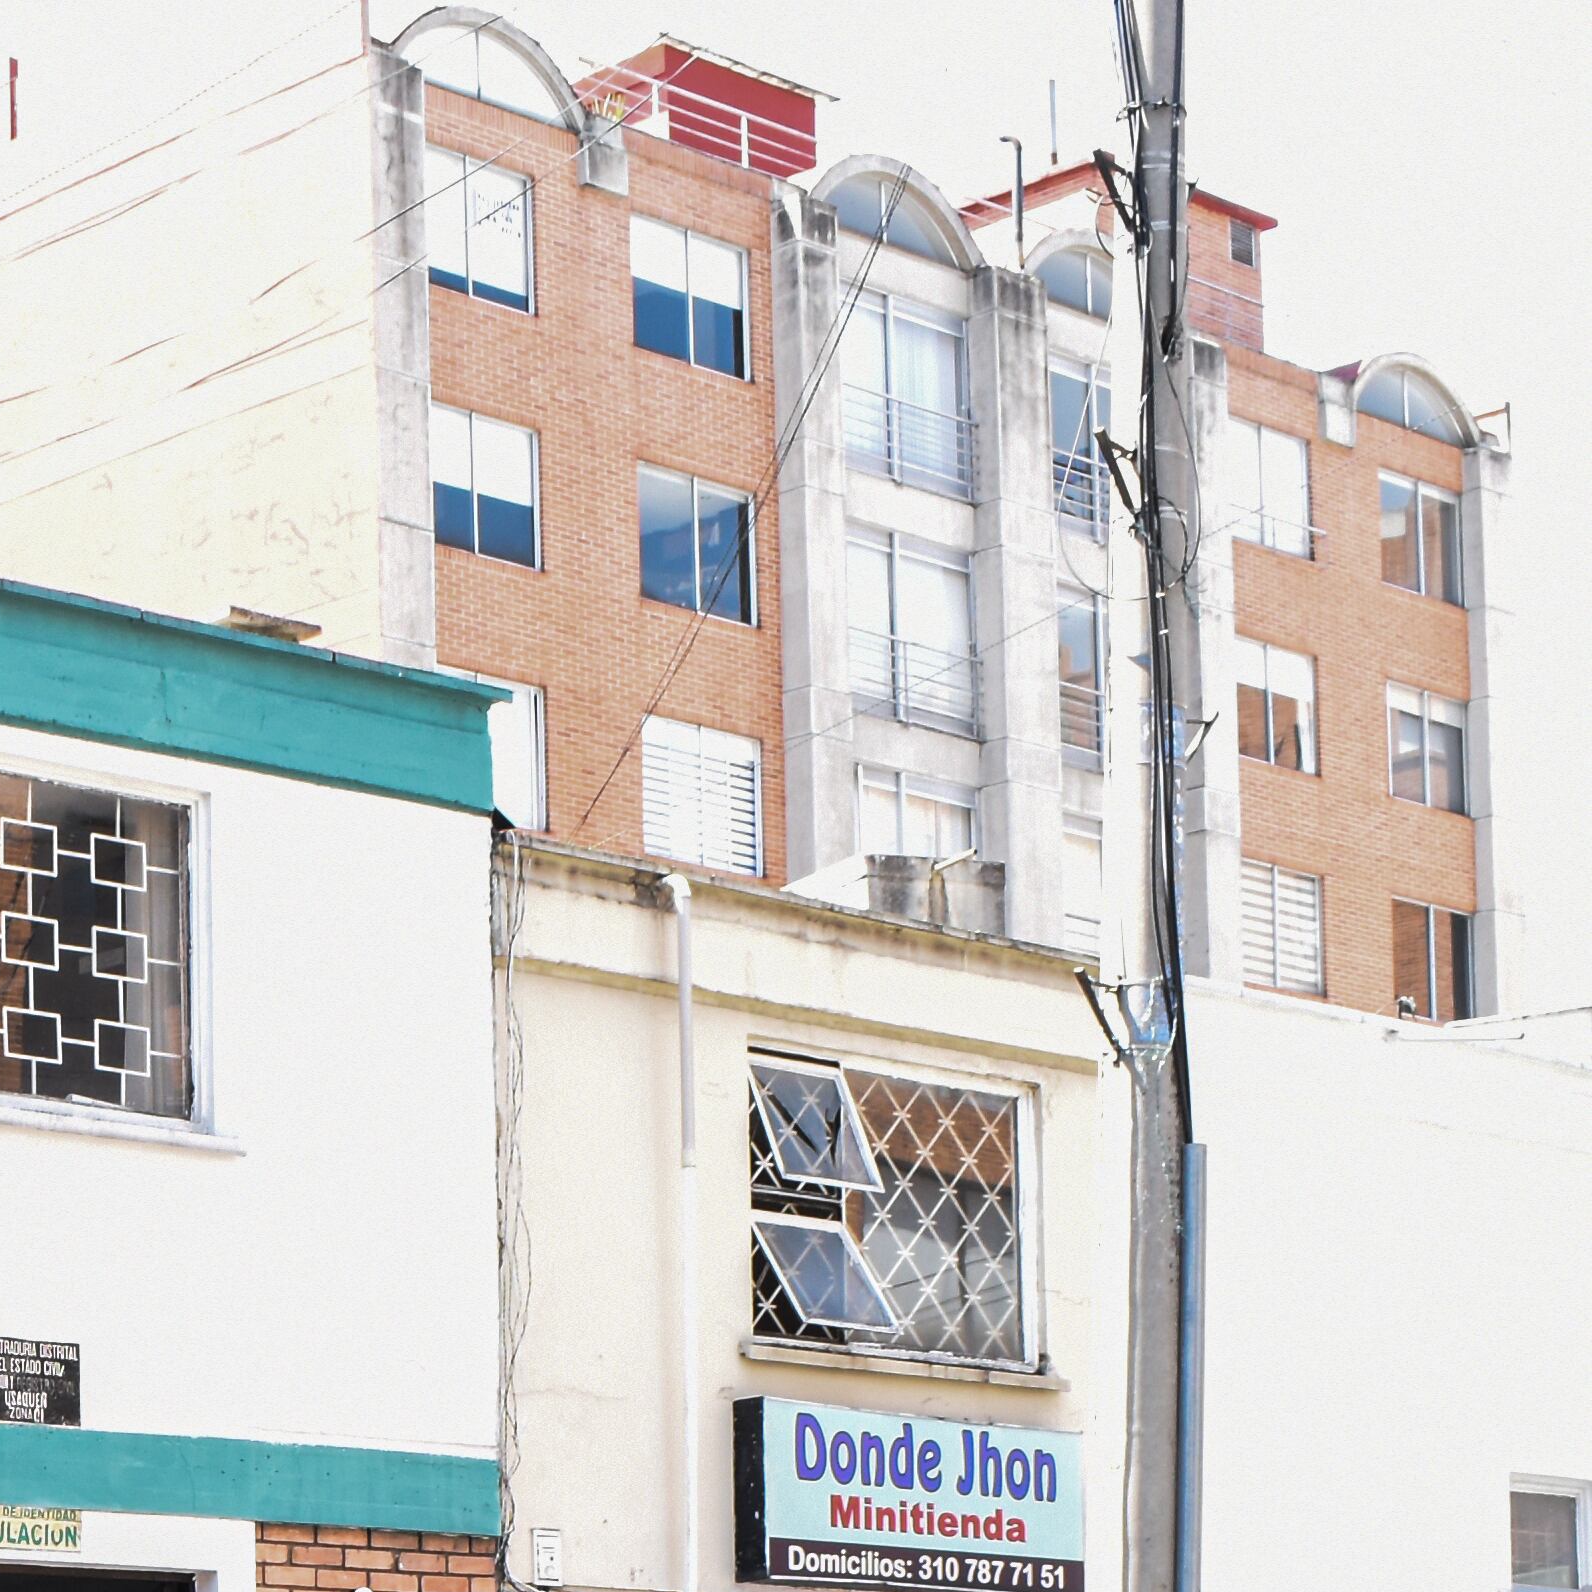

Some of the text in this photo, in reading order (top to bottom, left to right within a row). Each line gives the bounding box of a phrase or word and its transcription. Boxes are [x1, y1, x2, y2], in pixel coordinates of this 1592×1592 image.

[10, 1357, 41, 1375] ESTADO
[793, 1411, 1058, 1503] Donde Jhon
[2, 1505, 16, 1518] DE
[829, 1493, 1028, 1544] Minitienda
[787, 1544, 1065, 1591] Domicilios: 310 787 71 51
